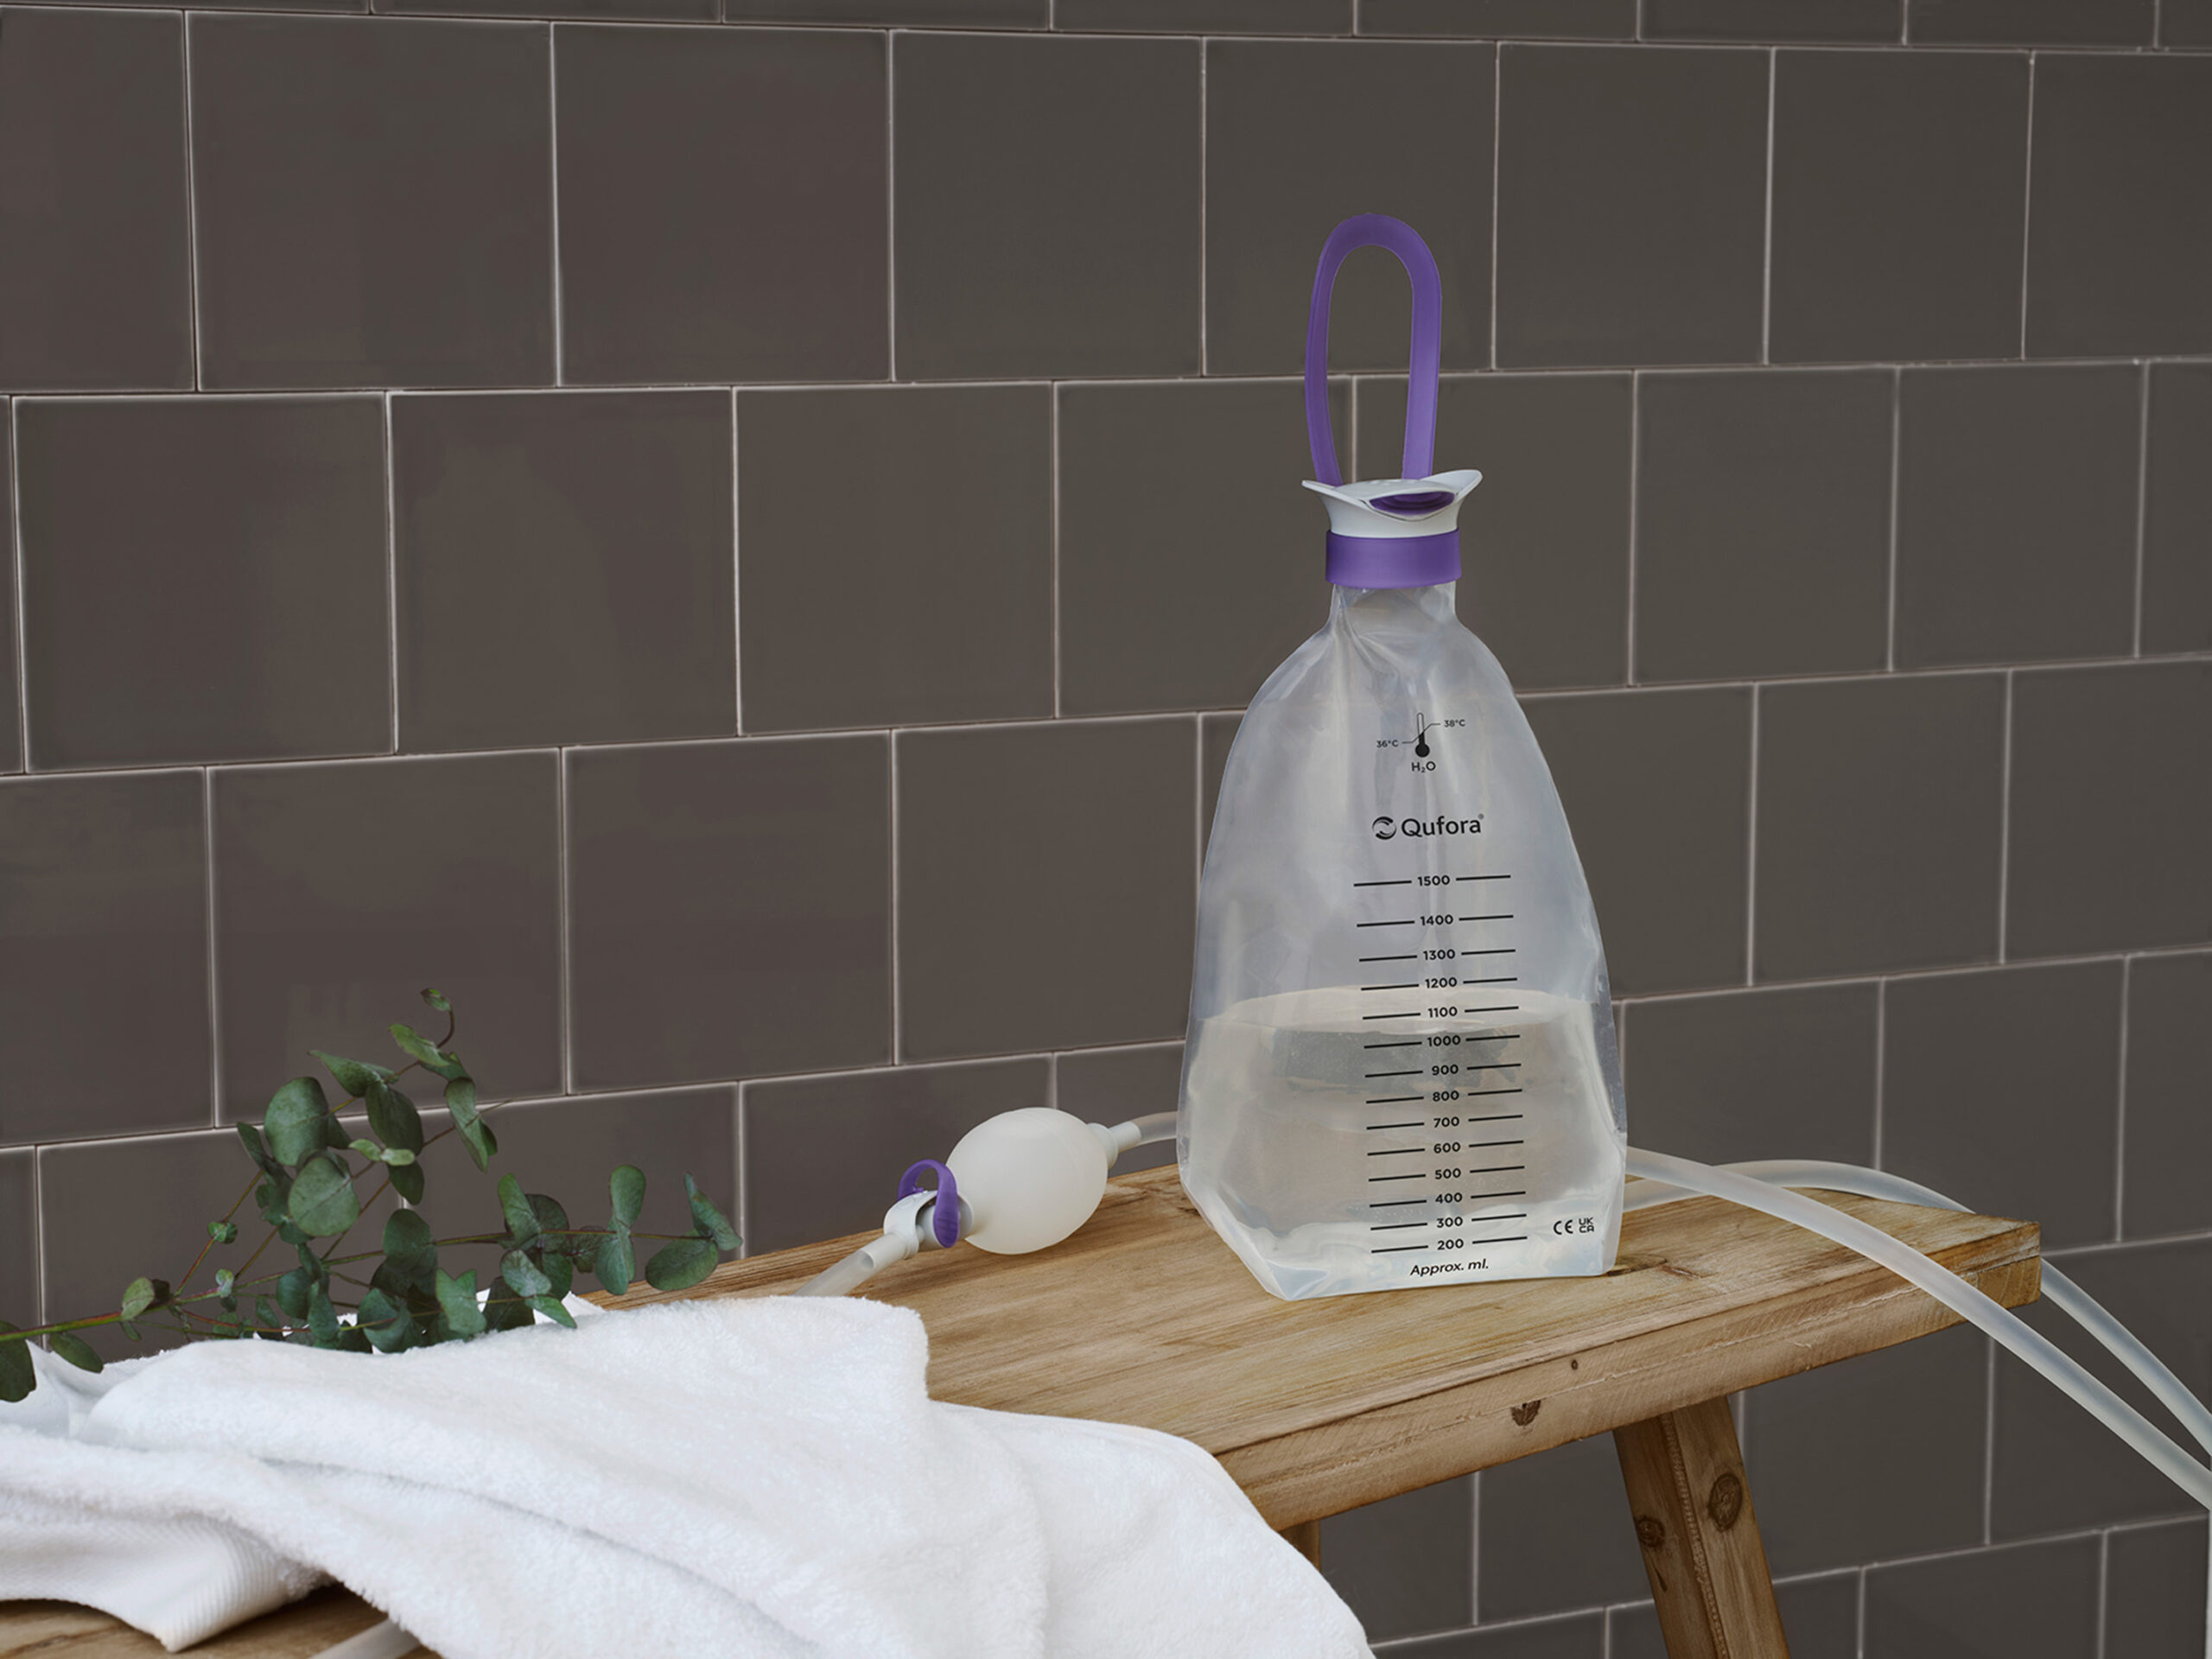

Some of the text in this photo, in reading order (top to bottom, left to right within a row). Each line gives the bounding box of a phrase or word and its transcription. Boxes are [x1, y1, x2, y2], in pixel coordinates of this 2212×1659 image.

[1444, 719, 1465, 728] 38°C
[1376, 740, 1398, 748] 36°C
[1417, 874, 1451, 887] 1500
[1420, 914, 1453, 926] 1400
[1423, 949, 1456, 961] 1300
[1425, 976, 1458, 988] 1200
[1427, 1006, 1458, 1018] 1100
[1427, 1033, 1461, 1047] 1000
[1431, 1065, 1459, 1077] 900
[1432, 1089, 1460, 1102] 800
[1433, 1116, 1459, 1128] 700
[1433, 1141, 1461, 1154] 600
[1434, 1167, 1461, 1179] 500
[1435, 1192, 1463, 1205] 400
[1437, 1216, 1464, 1228] 300
[1579, 1217, 1594, 1225] UK
[1579, 1224, 1595, 1233] CA
[1437, 1238, 1464, 1250] 200
[1410, 1258, 1489, 1277] Approx. ml.
